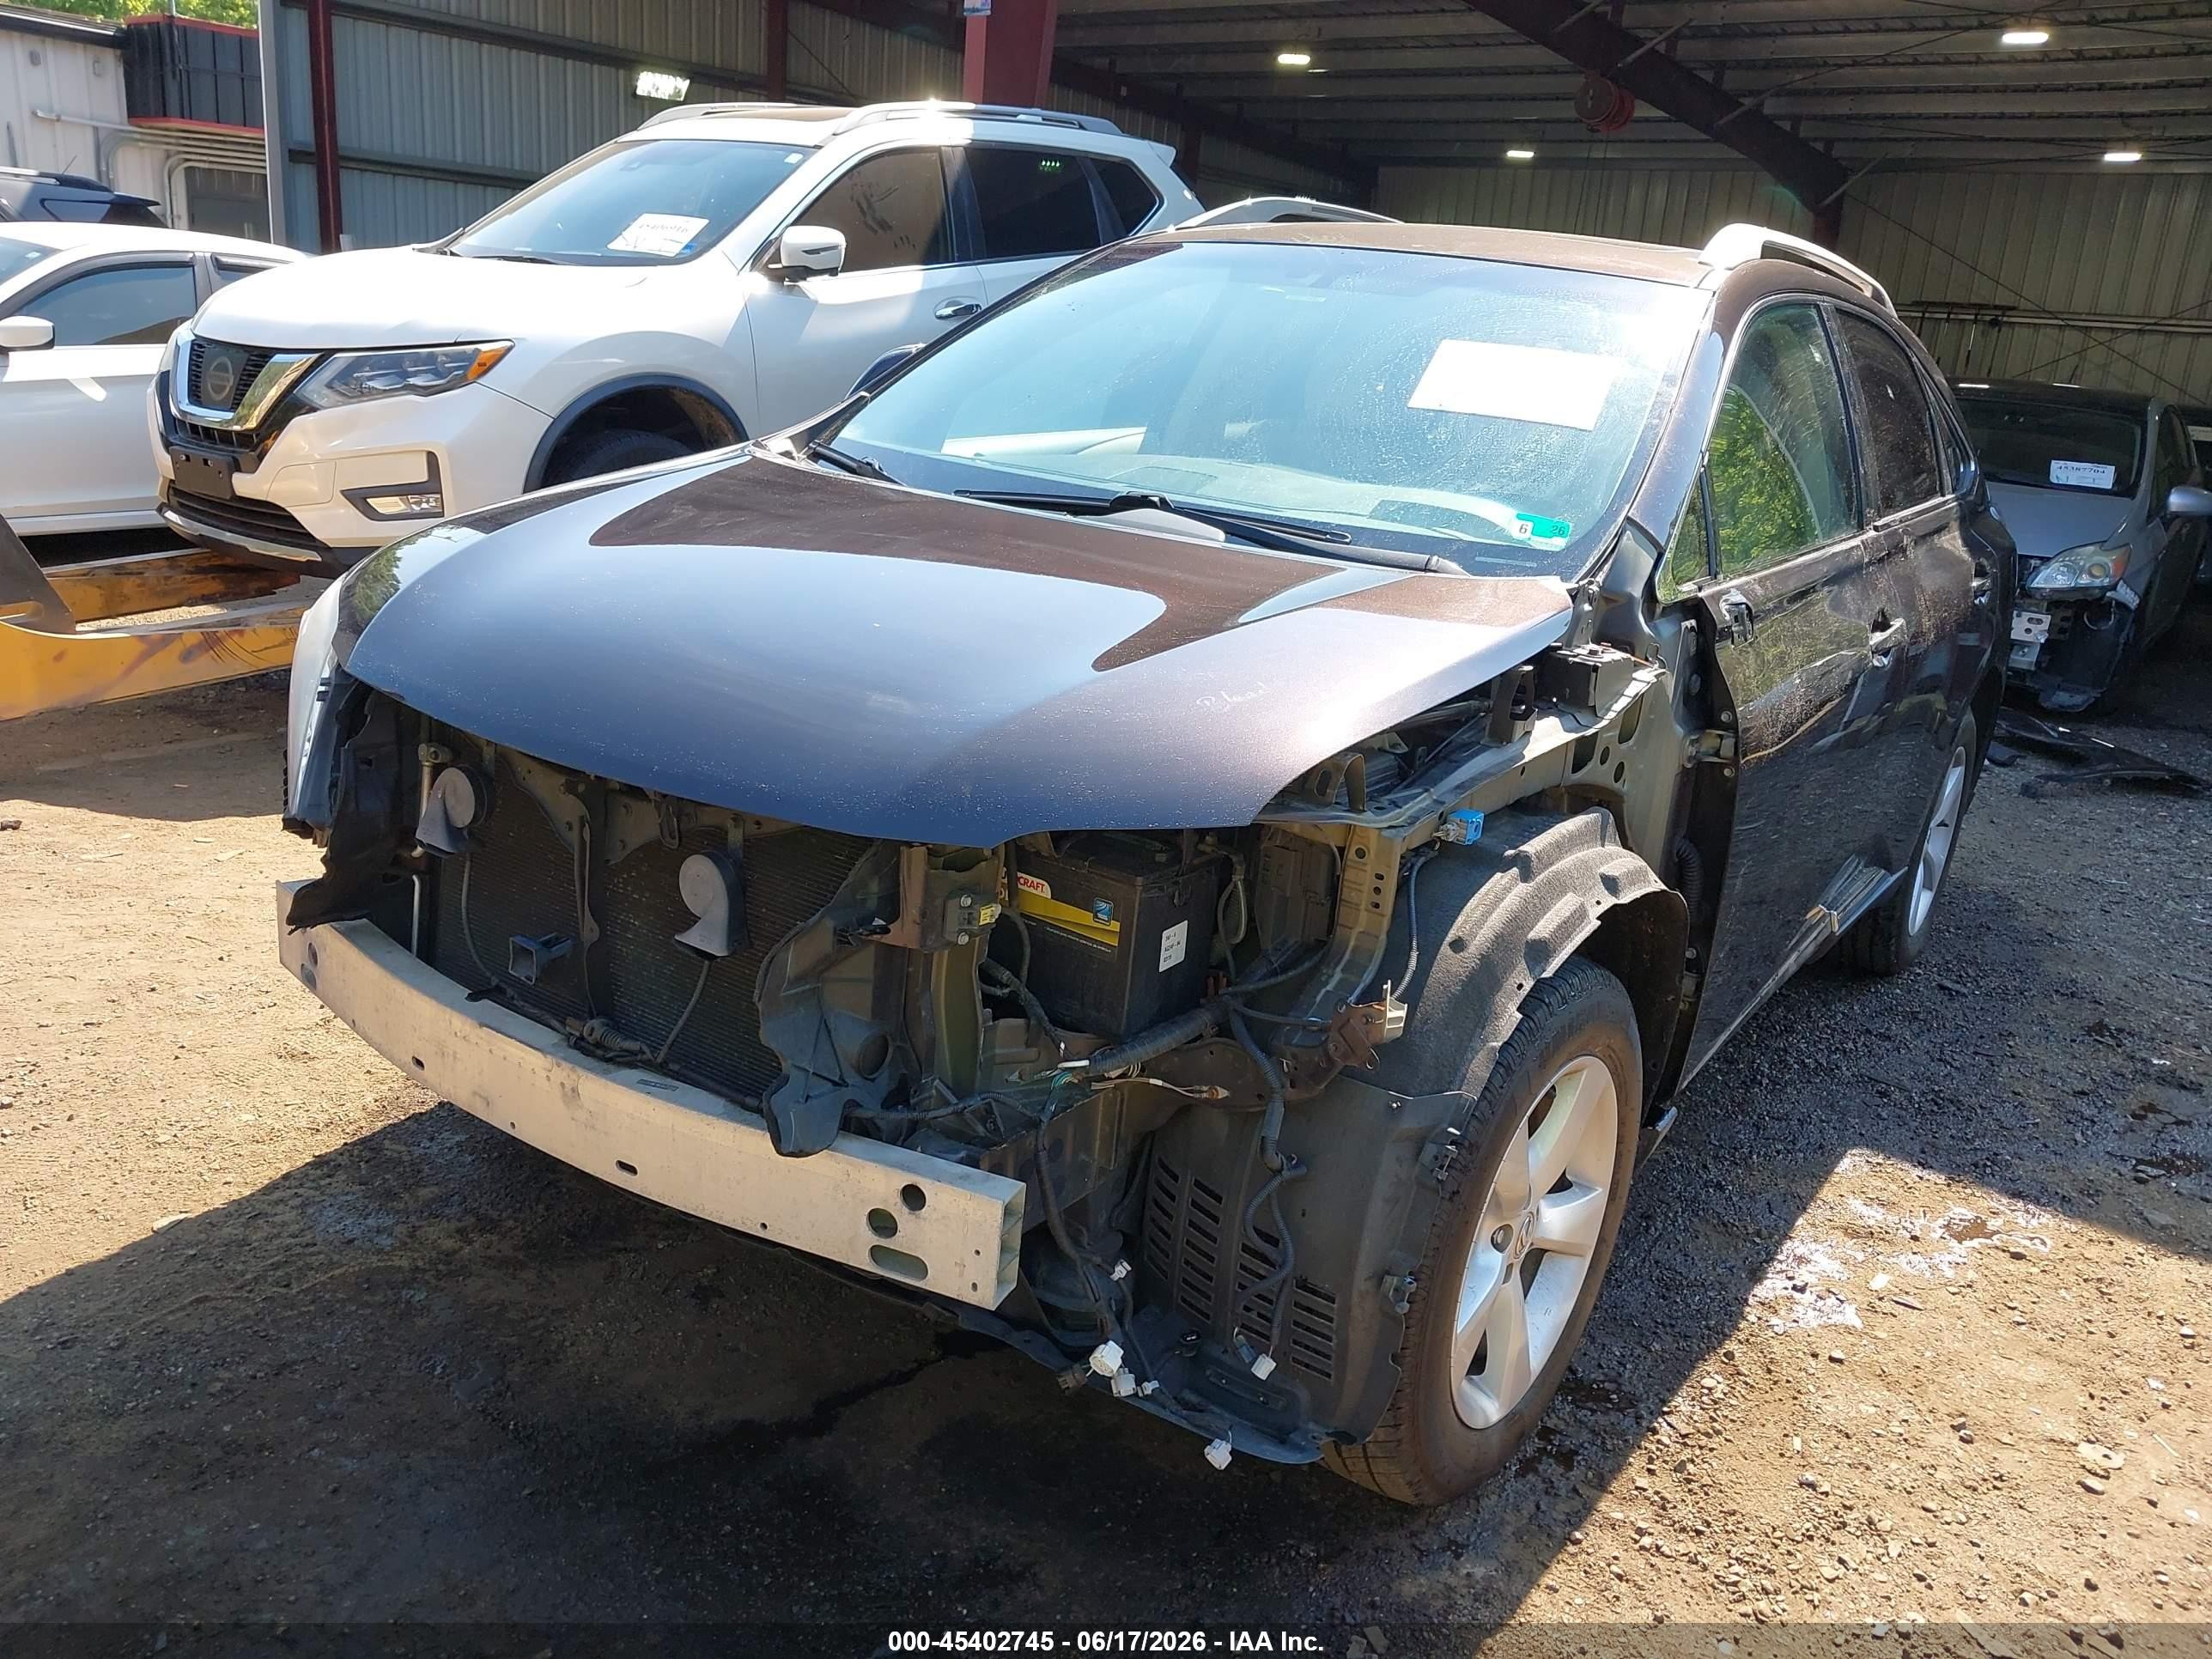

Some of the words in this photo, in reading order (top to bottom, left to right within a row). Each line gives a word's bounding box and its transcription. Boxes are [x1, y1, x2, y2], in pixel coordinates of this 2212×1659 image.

[1518, 523, 1528, 533] 6
[1552, 525, 1565, 535] 26
[1017, 876, 1046, 893] CRAFT
